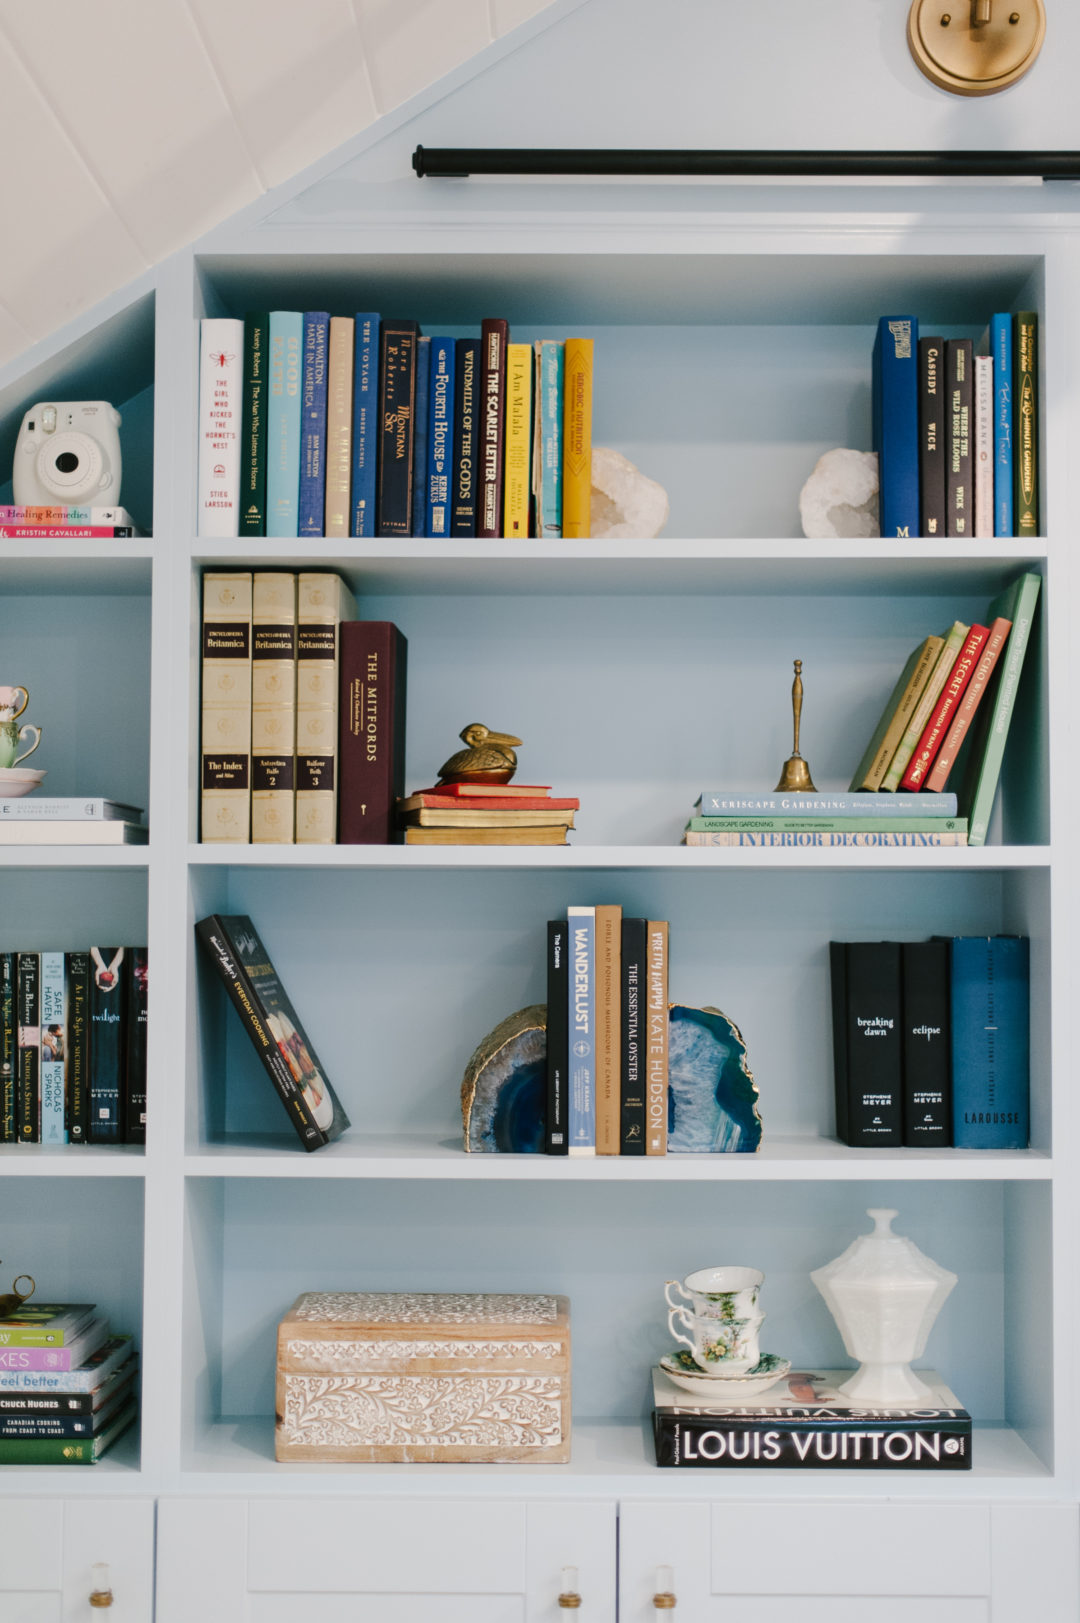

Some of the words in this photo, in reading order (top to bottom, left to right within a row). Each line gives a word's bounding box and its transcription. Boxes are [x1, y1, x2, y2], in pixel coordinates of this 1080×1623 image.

[251, 328, 261, 350] Monty
[306, 324, 315, 351] MADE
[315, 324, 325, 344] SAM
[252, 352, 261, 377] Roberts
[272, 336, 283, 396] FAITH
[287, 337, 298, 396] GOOD
[306, 353, 314, 364] IN
[315, 344, 324, 384] WALTON
[401, 339, 410, 372] Nora
[438, 361, 446, 374] THE
[362, 348, 370, 392] VOYAGE
[387, 346, 398, 399] Roberts
[462, 350, 474, 414] WINDMILLS
[487, 372, 499, 393] THE
[513, 374, 523, 391] Am
[927, 348, 939, 395] CASSIDY
[252, 387, 260, 399] The
[305, 365, 314, 407] AMERICA
[434, 375, 449, 419] FOURTH
[575, 372, 584, 407] AEROBIC
[1024, 387, 1032, 400] The
[252, 400, 260, 416] Man
[952, 390, 961, 412] WILD
[252, 417, 260, 433] Who
[462, 416, 472, 430] OF
[486, 396, 499, 442] SCARLET
[512, 397, 524, 435] Malala
[952, 414, 961, 437] ROSE
[960, 406, 968, 437] WHERE
[312, 435, 320, 449] SAM
[434, 421, 448, 461] HOUSE
[927, 423, 937, 452] WICK
[980, 417, 988, 446] BANK
[251, 434, 259, 457] Listens
[462, 435, 471, 456] THE
[952, 438, 960, 472] BLOOMS
[960, 438, 968, 456] THE
[312, 449, 320, 477] WALTON
[485, 444, 497, 481] LETTER
[430, 475, 439, 503] ZUKUS
[438, 475, 448, 503] KERRY
[459, 458, 473, 499] GODS
[955, 486, 964, 509] WICK
[7, 510, 43, 520] Healing
[46, 510, 88, 519] Remedies
[208, 639, 244, 647] Britannica
[255, 641, 292, 649] Britannica
[299, 641, 334, 649] Britannica
[965, 634, 983, 656] THE
[991, 634, 1002, 648] THE
[367, 653, 378, 681] THE
[948, 658, 972, 698] SECRET
[976, 652, 996, 681] ECHO
[965, 682, 982, 711] WITHIN
[367, 688, 377, 762] MITFORDS
[936, 698, 953, 727] RHONDA
[926, 729, 940, 750] BYRNE
[949, 719, 966, 748] BENSON
[208, 762, 222, 770] The
[223, 762, 242, 770] Index
[269, 777, 276, 786] 2
[312, 777, 319, 786] 3
[711, 799, 776, 808] XERISCAPE
[781, 799, 846, 808] GARDENING
[739, 832, 823, 846] INTERIOR
[830, 833, 941, 846] DECORATING
[25, 974, 34, 993] True
[574, 928, 589, 1034] WANDERLUST
[629, 964, 638, 985] THE
[74, 984, 84, 994] At
[25, 994, 34, 1024] Believer
[44, 986, 53, 1021] HAVEN
[54, 991, 62, 1015] SAFE
[74, 997, 84, 1014] First
[92, 1008, 120, 1023] twilight
[234, 981, 254, 1015] EVERYDAY
[250, 1015, 270, 1047] COOKING
[628, 987, 638, 1041] ESSENTIAL
[73, 1017, 83, 1037] Sight
[650, 1014, 663, 1056] KATE
[857, 1017, 894, 1029] breaking
[864, 1027, 887, 1036] dawn
[912, 1025, 940, 1041] eclipse
[24, 1051, 33, 1090] NICHOLAS
[628, 1042, 638, 1081] OYSTER
[44, 1073, 53, 1108] SPARKS
[54, 1066, 62, 1112] NICHOLAS
[73, 1087, 81, 1116] SPARKS
[650, 1060, 663, 1129] HUDSON
[24, 1092, 33, 1120] SPARKS
[965, 1112, 1019, 1124] LAROUSSE
[23, 1375, 59, 1386] better
[0, 1400, 26, 1408] CHUCK
[28, 1400, 59, 1408] HUGHES
[684, 1430, 781, 1460] LOUIS
[791, 1431, 940, 1461] VUITTON
